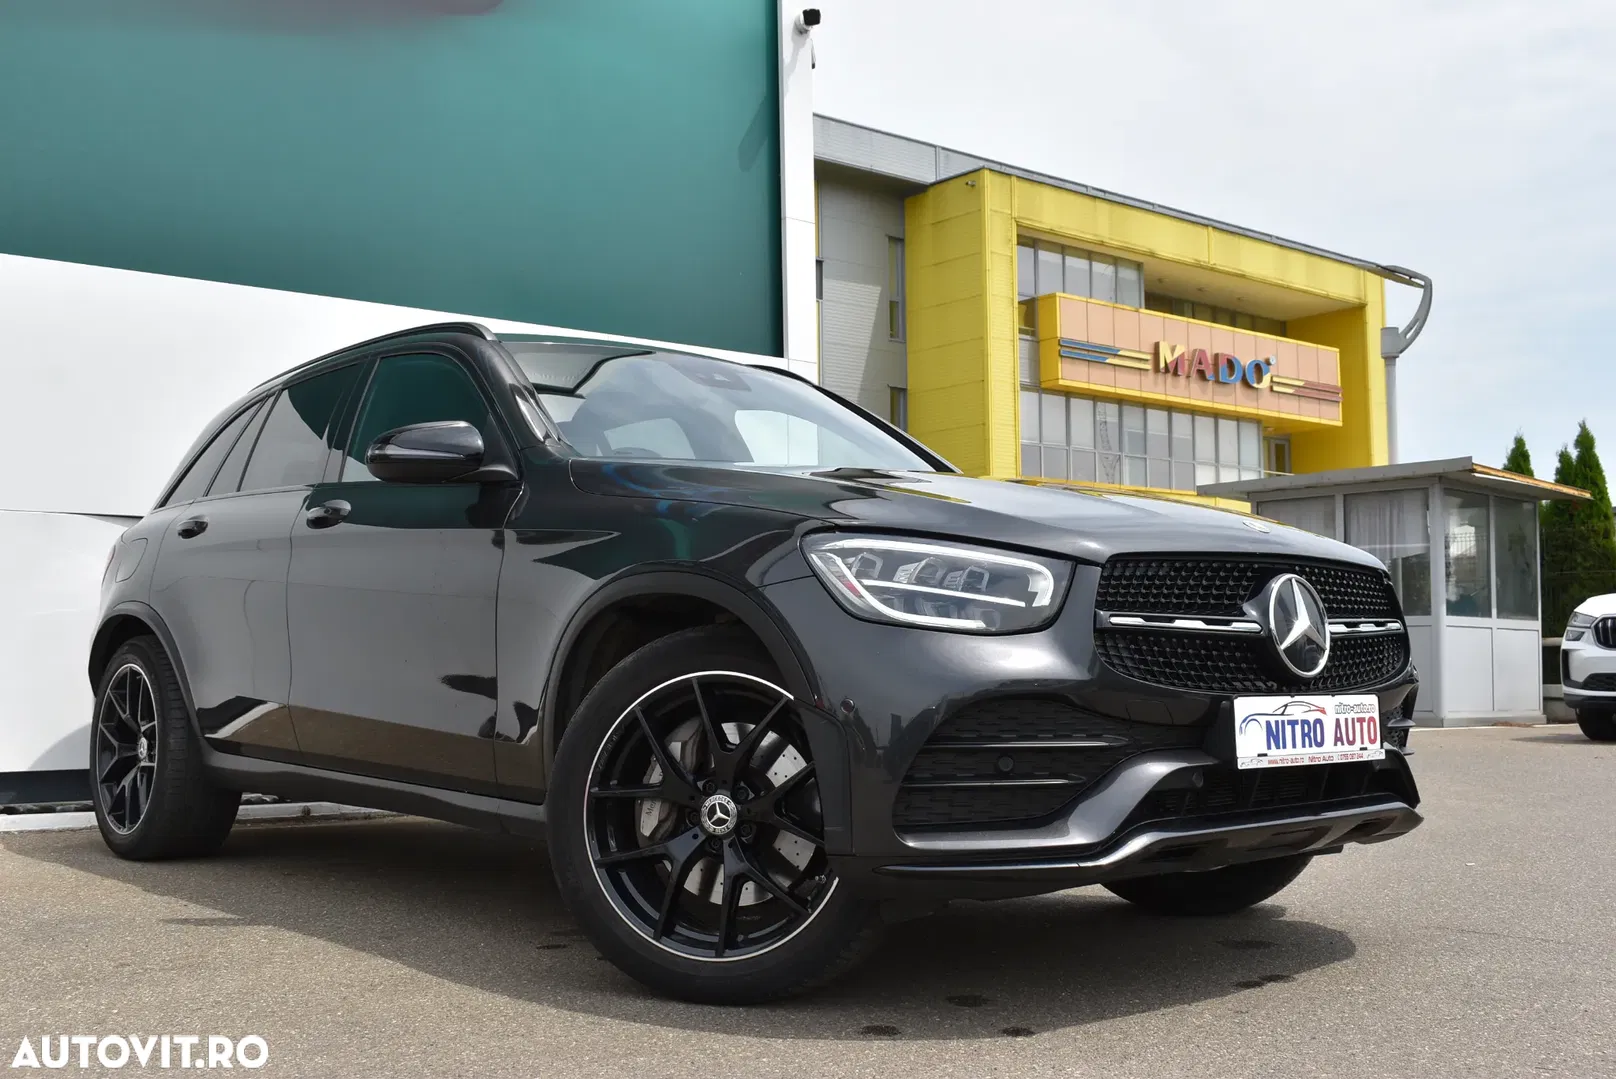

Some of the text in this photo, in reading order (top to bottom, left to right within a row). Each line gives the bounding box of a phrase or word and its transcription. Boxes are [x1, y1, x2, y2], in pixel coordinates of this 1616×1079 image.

[1154, 340, 1271, 389] MADO
[1265, 716, 1377, 750] NITRO AUTO
